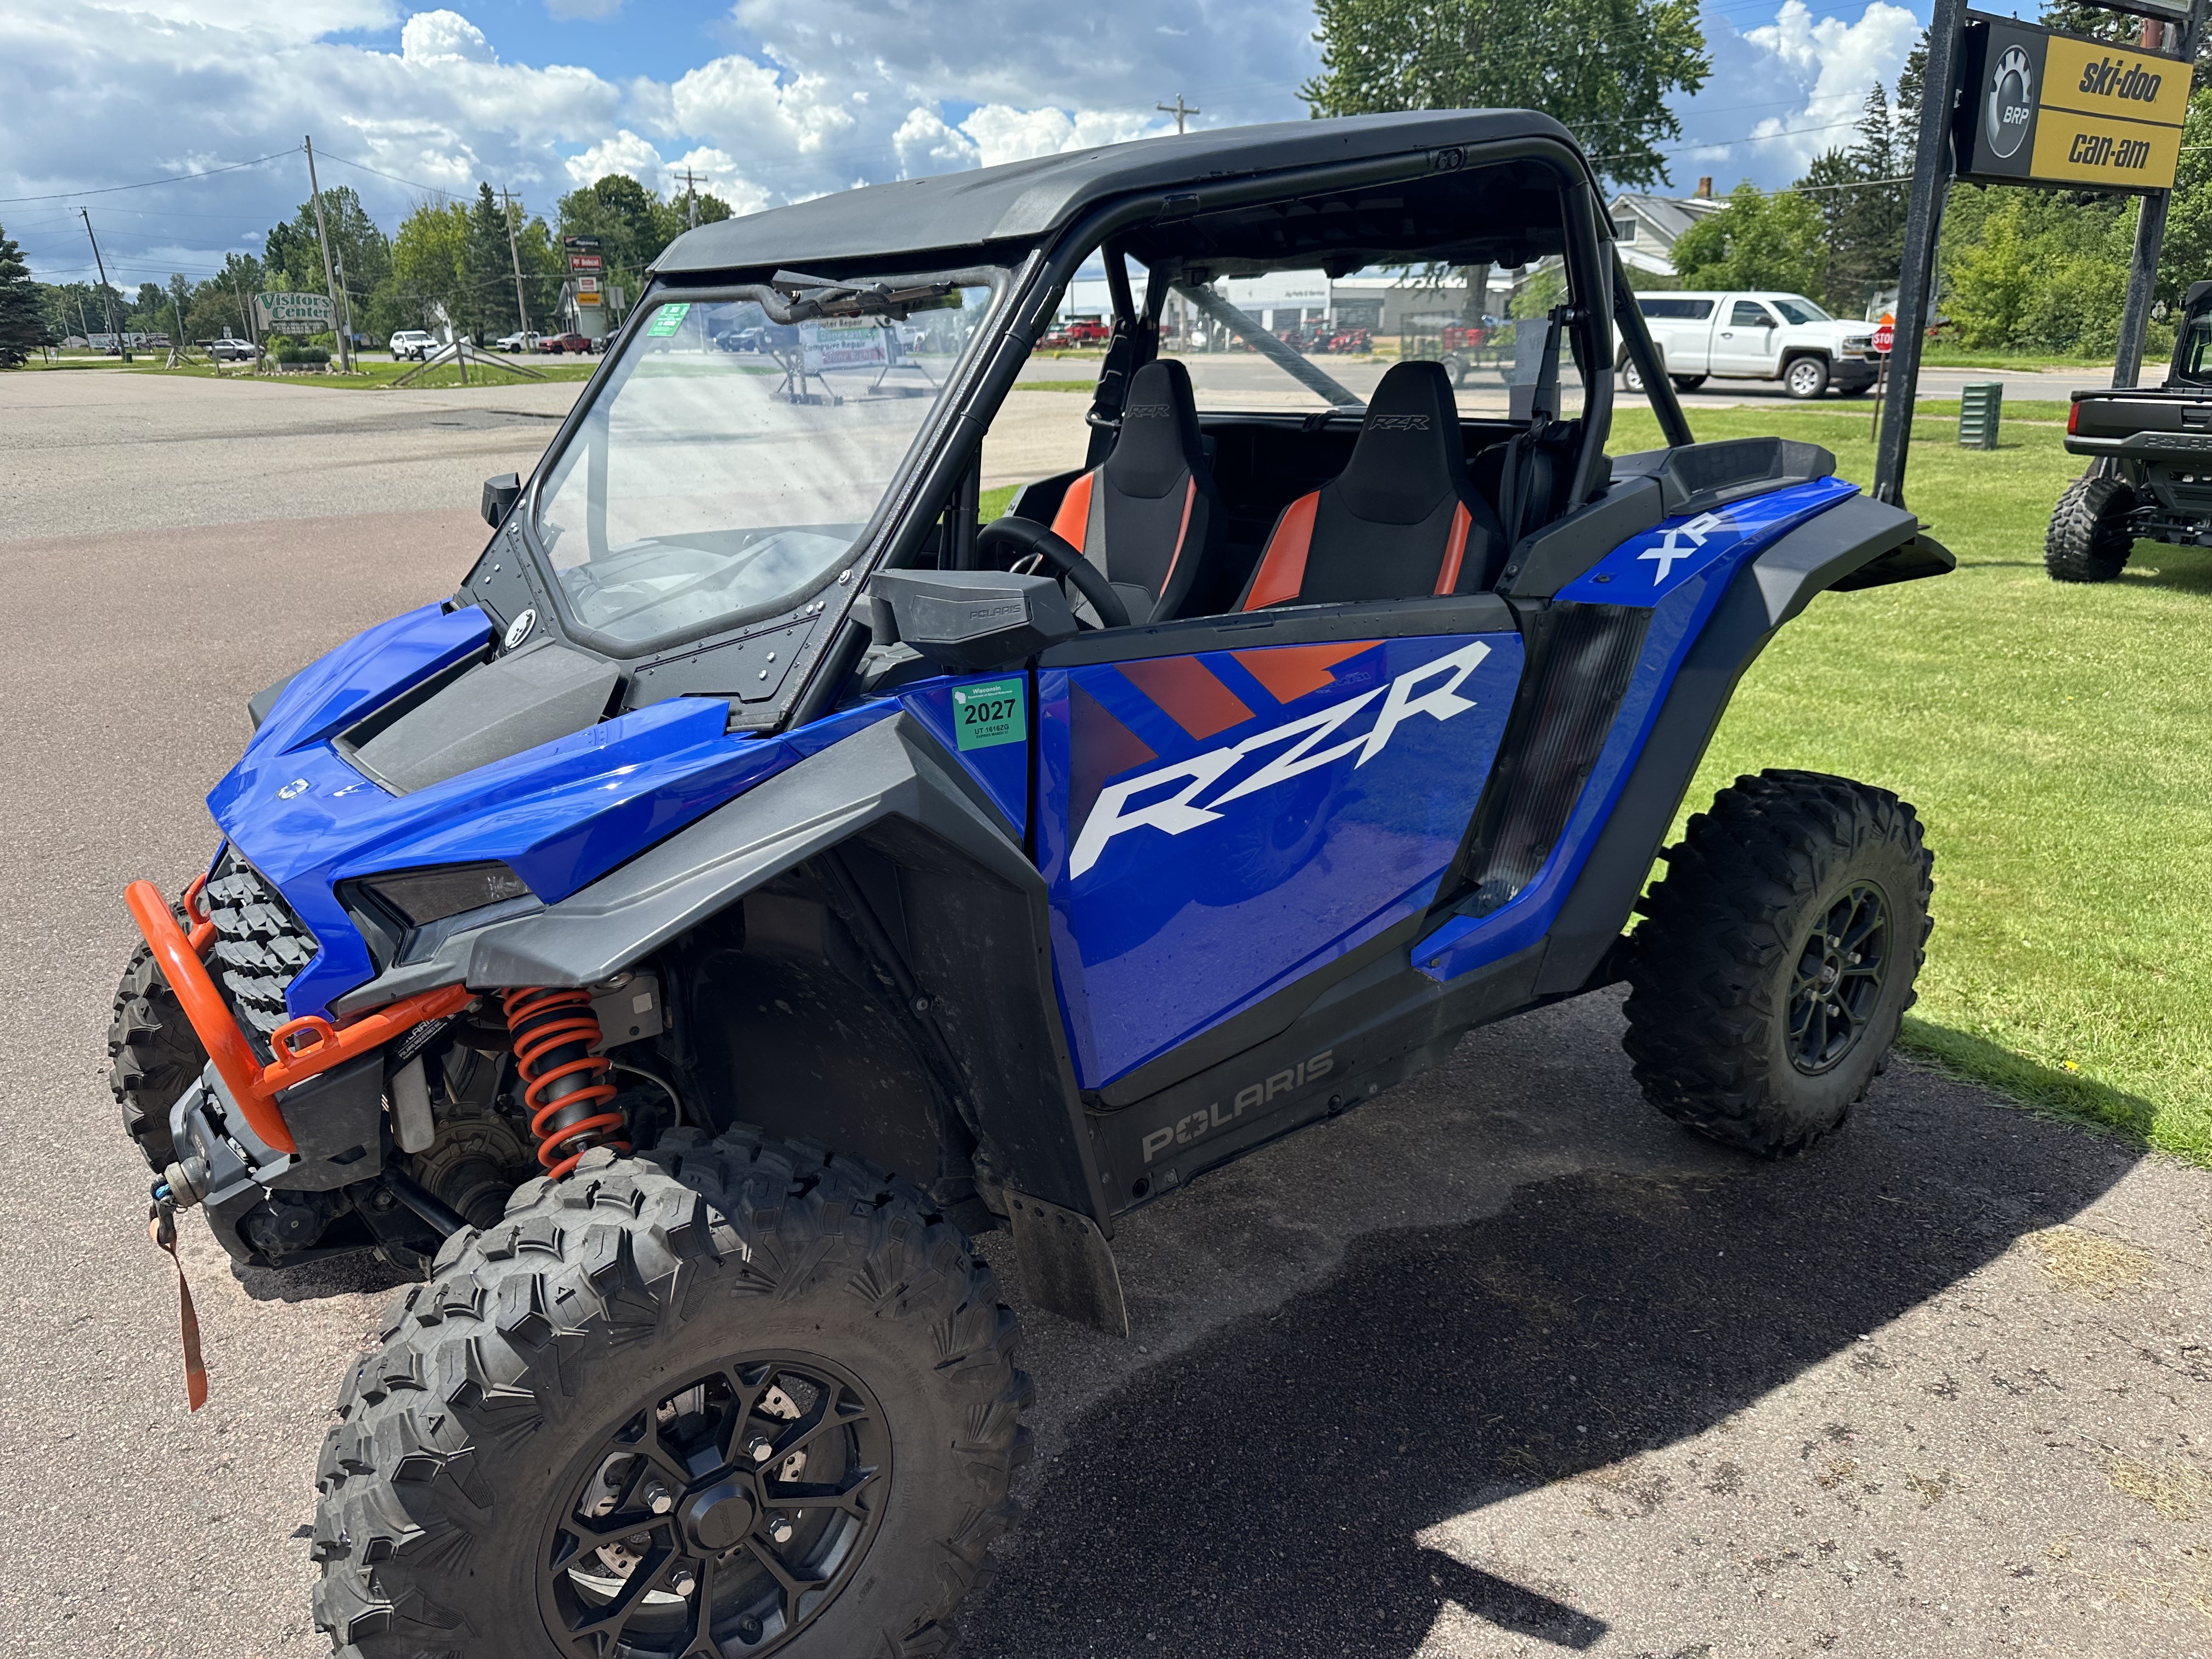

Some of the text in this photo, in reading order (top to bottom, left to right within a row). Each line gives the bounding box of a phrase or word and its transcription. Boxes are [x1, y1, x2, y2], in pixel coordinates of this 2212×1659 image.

[2079, 57, 2162, 103] ski-doo
[2003, 106, 2029, 125] BRP
[2068, 134, 2150, 169] can-am
[261, 294, 331, 309] Visitors
[272, 307, 331, 319] Center
[800, 319, 863, 330] Computer Repair
[804, 341, 866, 352] Computer Repair
[1127, 404, 1170, 419] RZR
[1368, 415, 1430, 431] RZR
[1637, 512, 1722, 586] XP
[970, 605, 1022, 620] POLARIS
[972, 686, 1001, 694] Wisconsin
[964, 698, 1015, 725] 2027
[1069, 640, 1492, 881] RZR
[399, 1043, 416, 1058] POLARIS
[1142, 1049, 1334, 1164] POLARIS
